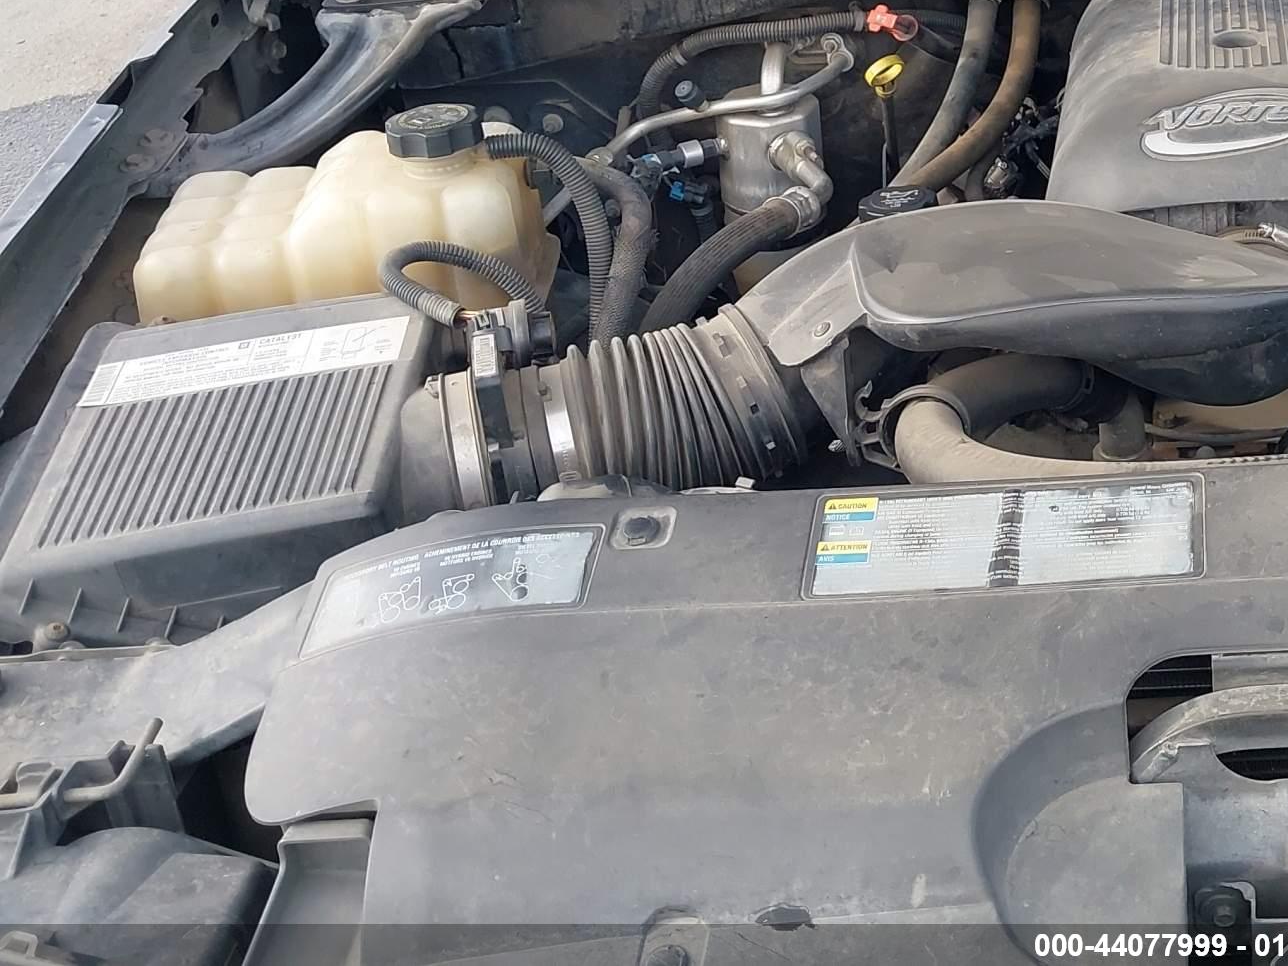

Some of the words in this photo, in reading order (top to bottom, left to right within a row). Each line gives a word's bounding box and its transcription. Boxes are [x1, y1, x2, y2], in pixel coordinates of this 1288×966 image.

[259, 333, 302, 345] CATALYST
[837, 501, 868, 511] CAUTION
[825, 513, 850, 522] NOTICE
[830, 542, 868, 552] ATTENTION
[818, 555, 835, 563] AVIS
